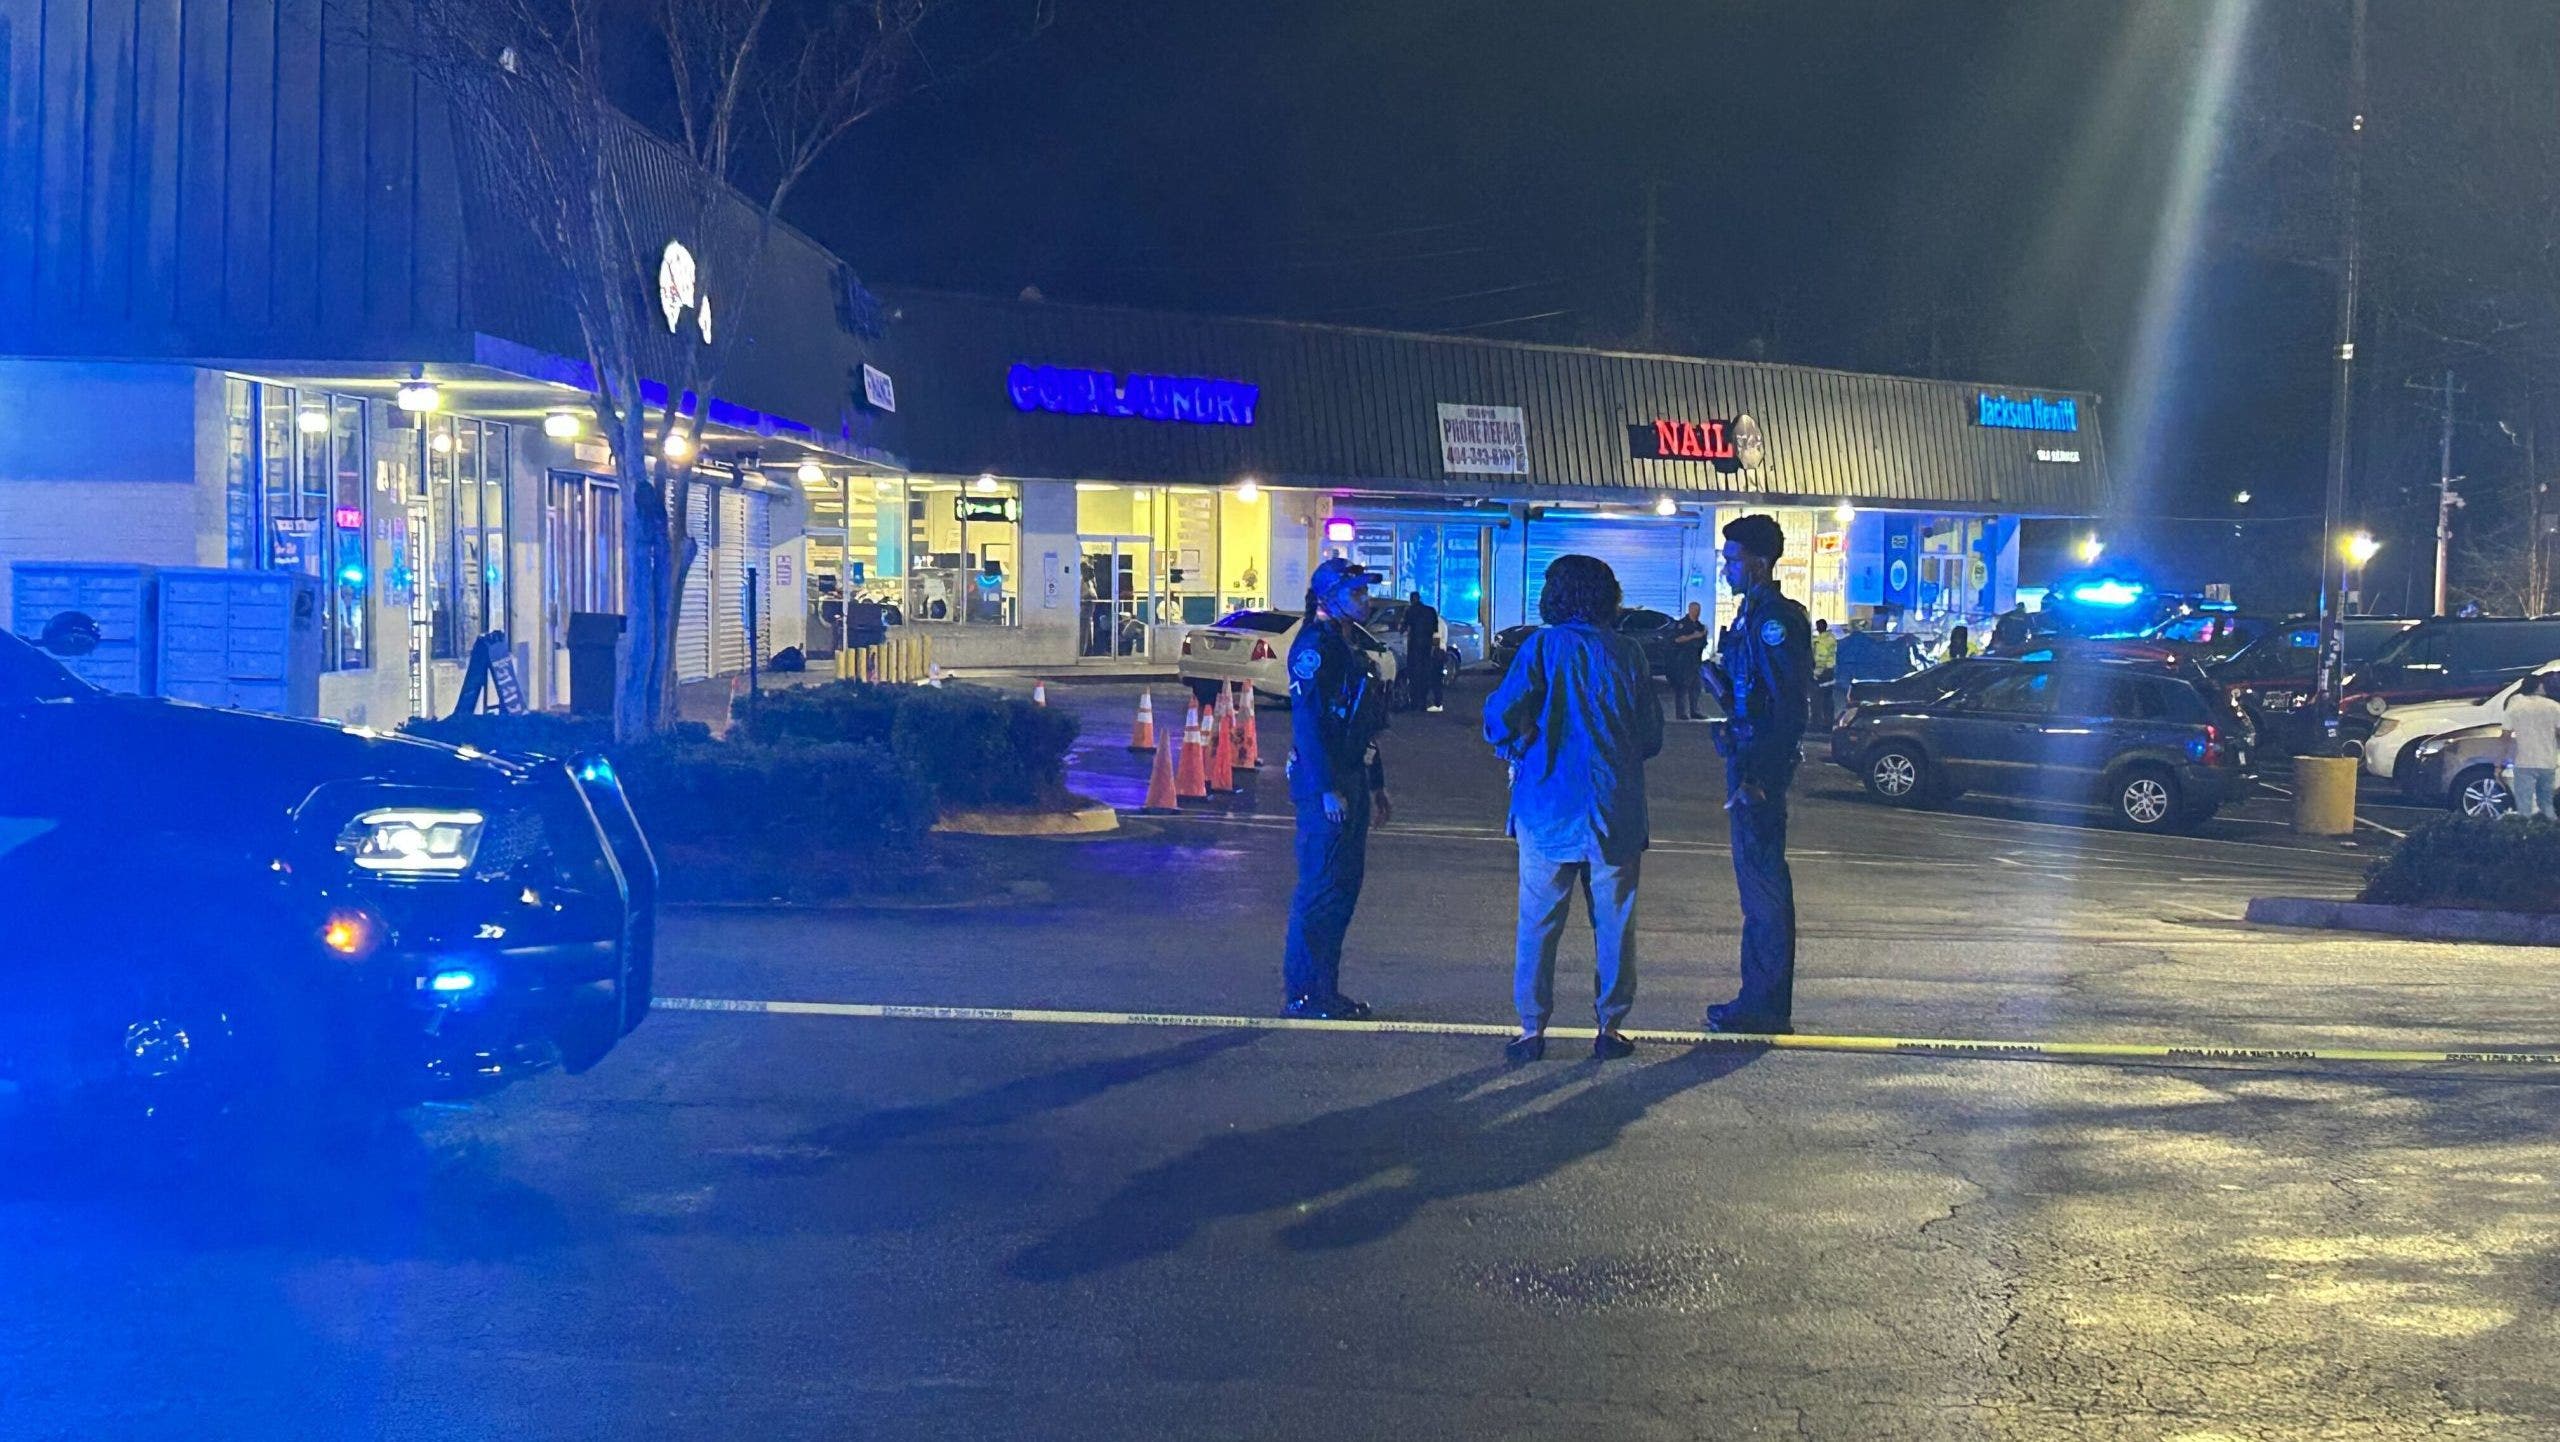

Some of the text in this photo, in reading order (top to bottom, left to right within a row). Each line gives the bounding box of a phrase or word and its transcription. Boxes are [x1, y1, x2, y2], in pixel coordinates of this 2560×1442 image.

[1979, 392, 2033, 429] Jackson
[1443, 419, 1482, 444] PHONE
[1656, 418, 1734, 458] NAIL
